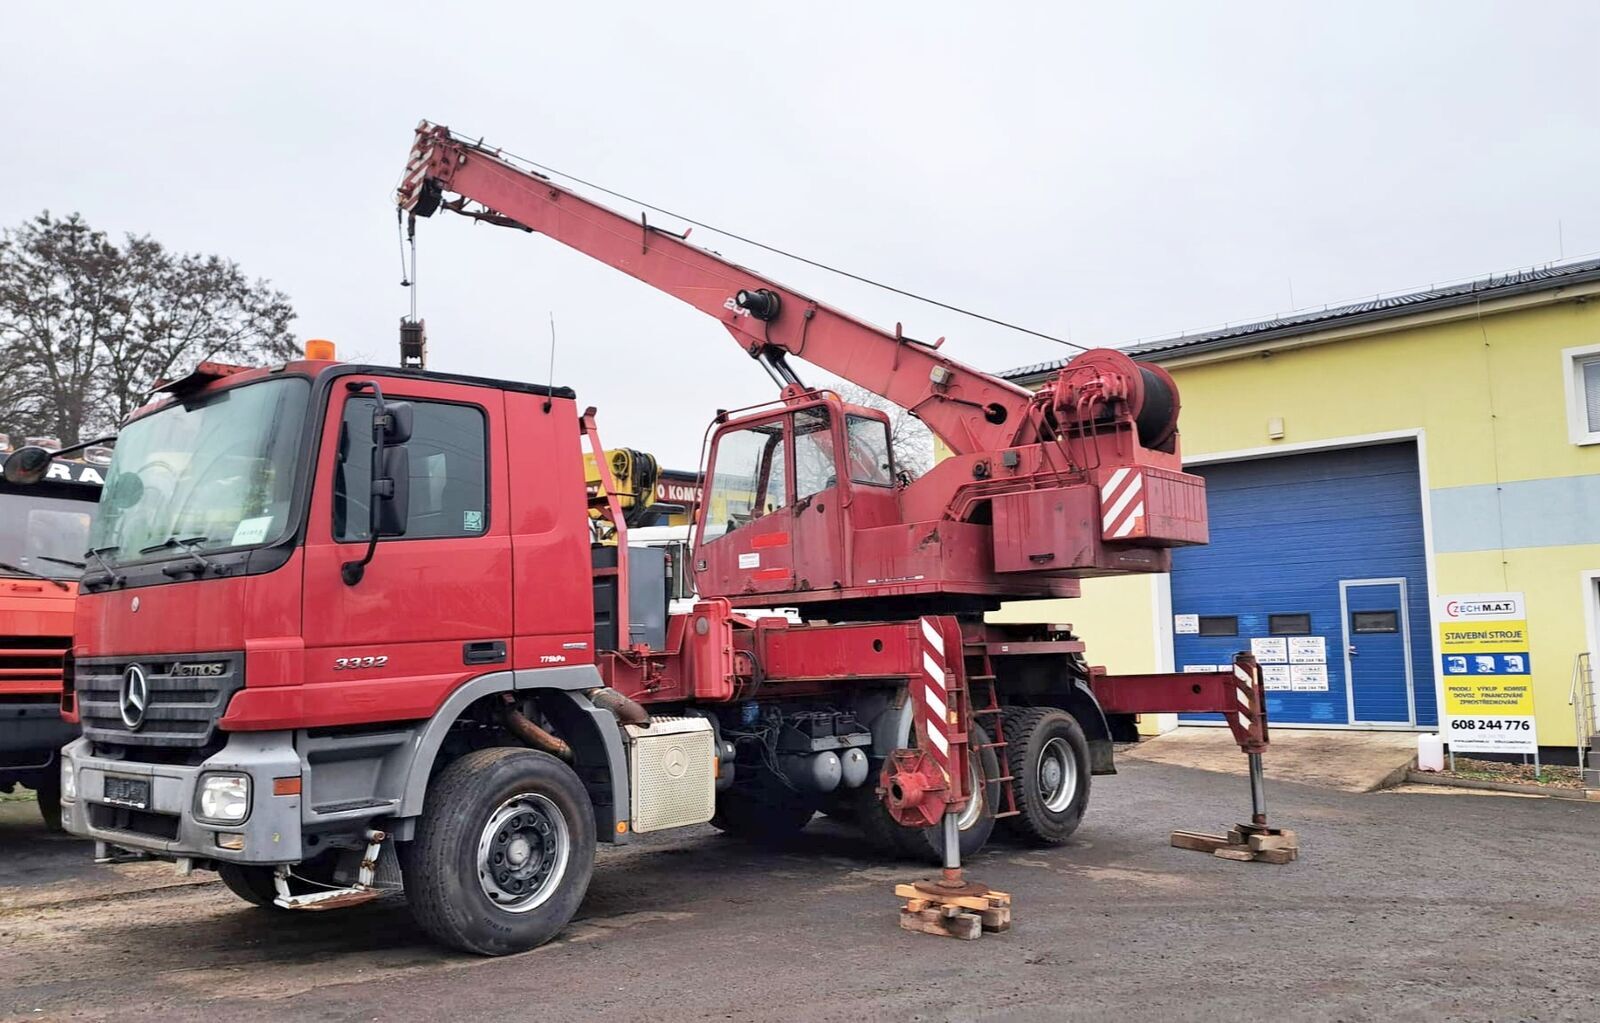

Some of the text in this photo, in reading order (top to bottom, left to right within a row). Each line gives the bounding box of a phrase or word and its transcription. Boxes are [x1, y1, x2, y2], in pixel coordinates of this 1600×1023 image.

[1482, 603, 1512, 612] M.A.T.
[1445, 630, 1522, 640] STAVEBNÍ STROJE
[333, 656, 388, 670] 3332
[1451, 720, 1530, 730] 608 244 776
